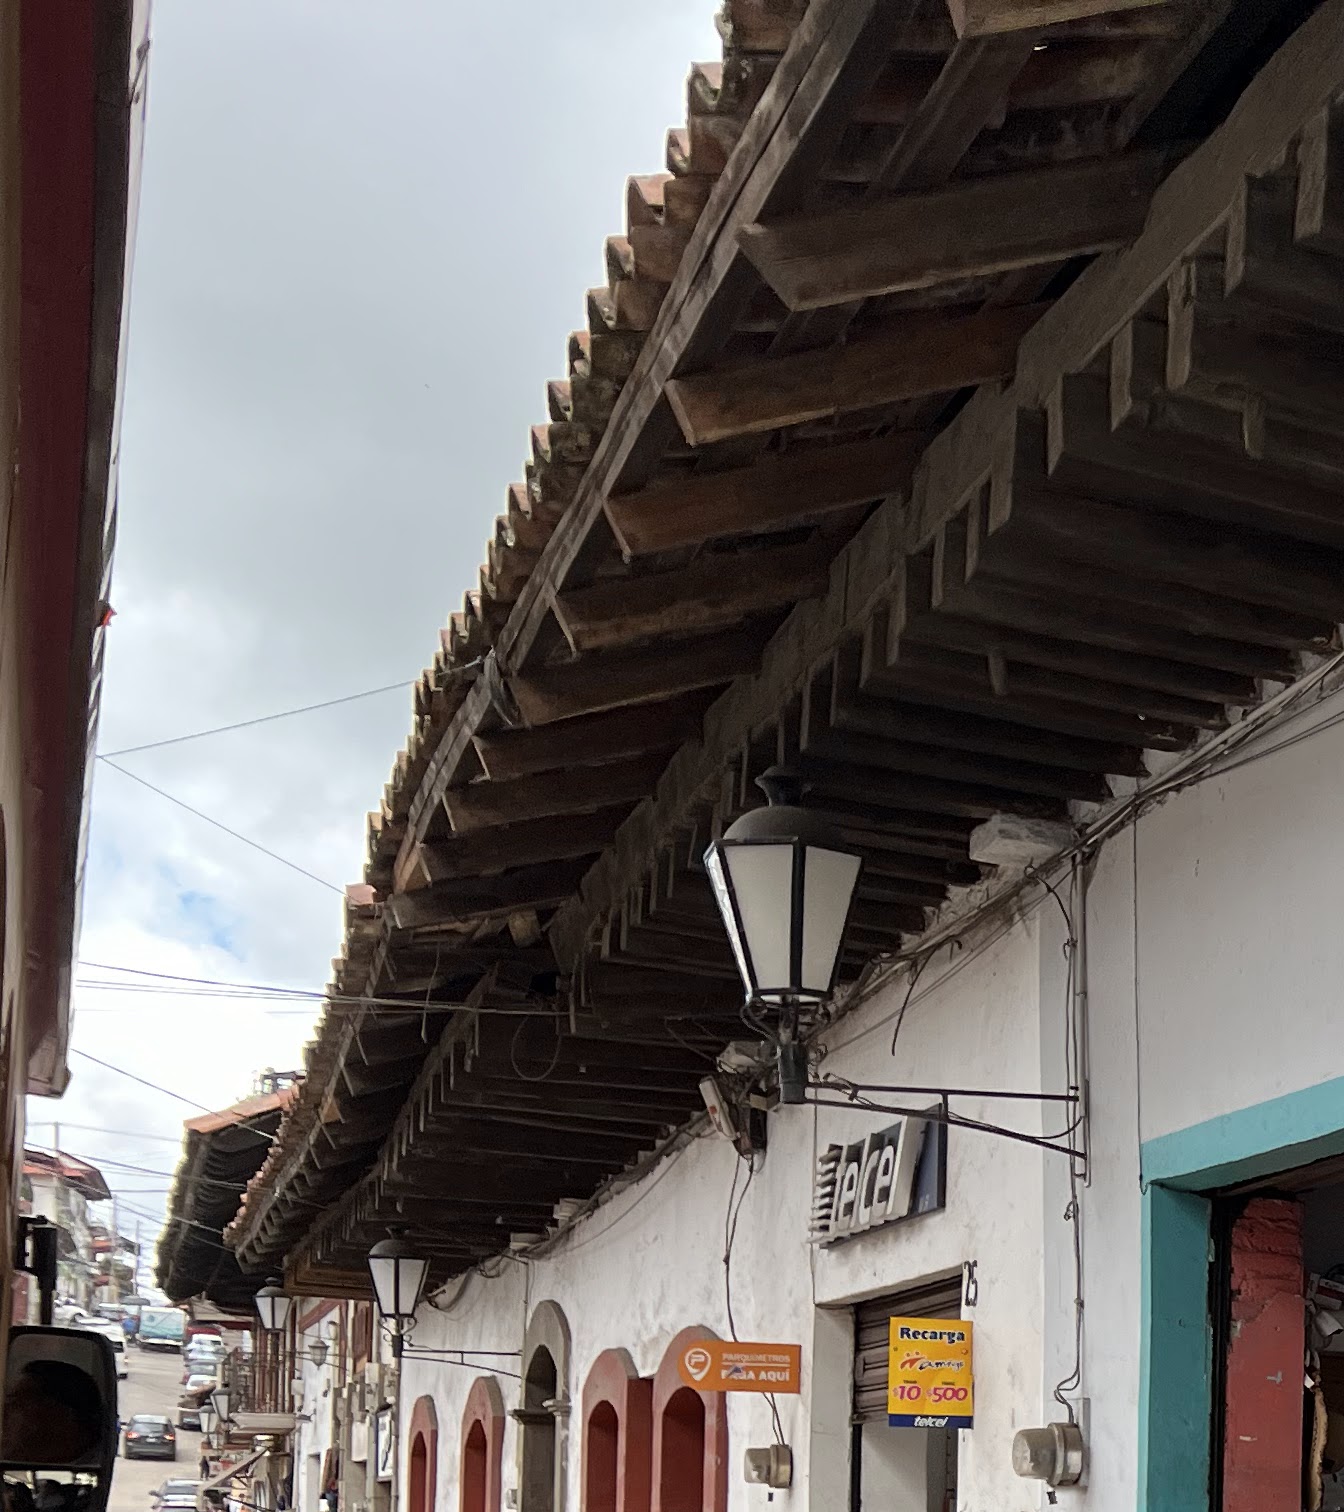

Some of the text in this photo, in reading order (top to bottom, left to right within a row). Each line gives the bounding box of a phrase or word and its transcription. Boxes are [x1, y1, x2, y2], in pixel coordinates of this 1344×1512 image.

[829, 1115, 912, 1236] telcel
[899, 1327, 966, 1344] Recarga
[759, 1368, 790, 1381] AQUÍ
[893, 1385, 969, 1403] $10 $500
[914, 1416, 949, 1428] telcel
